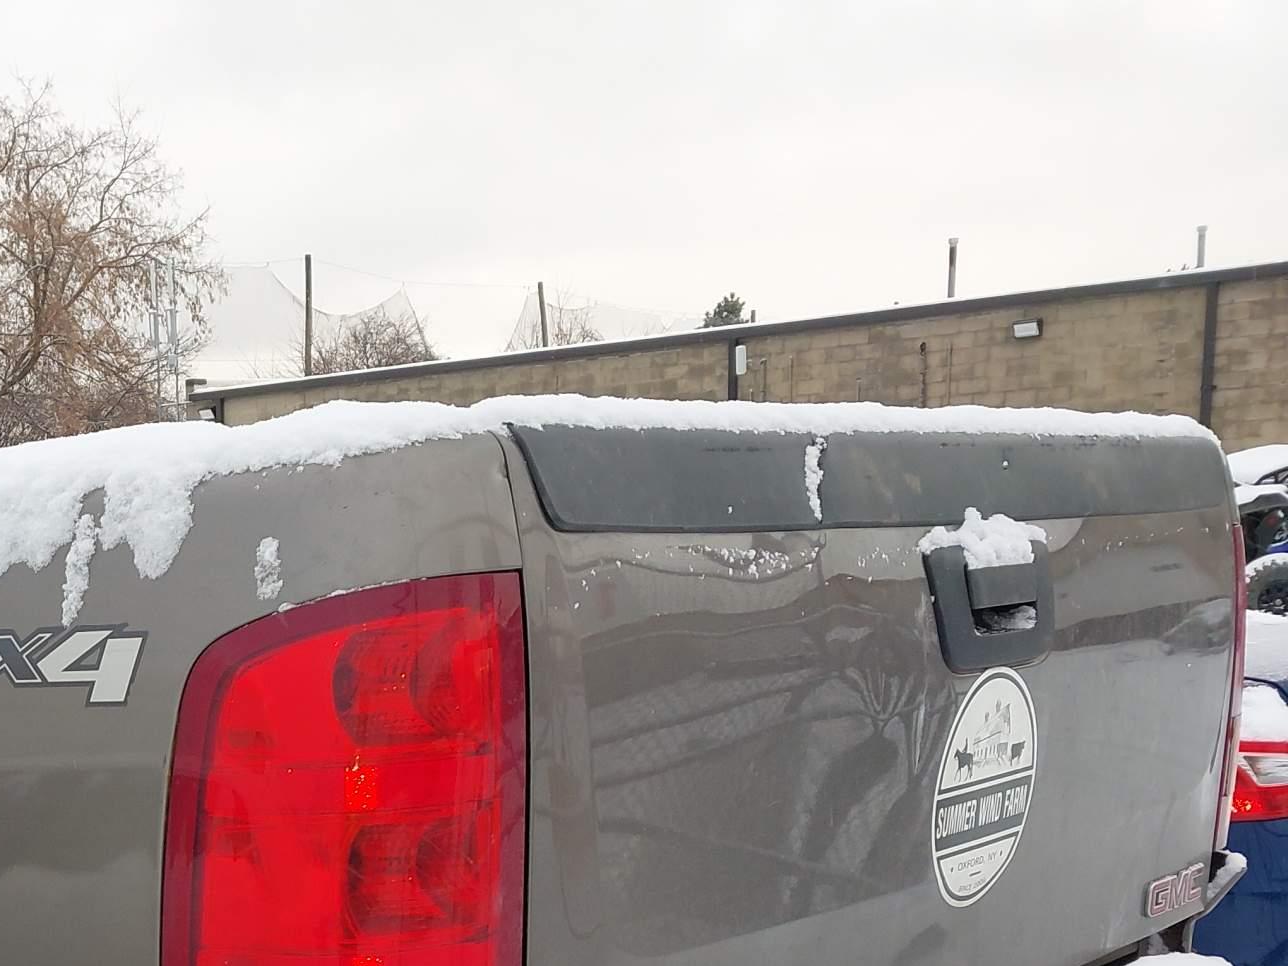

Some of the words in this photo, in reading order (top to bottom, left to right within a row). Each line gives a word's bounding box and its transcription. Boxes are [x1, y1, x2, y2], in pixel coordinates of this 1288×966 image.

[936, 799, 978, 840] SUMMER
[978, 791, 1003, 827] WIND
[1002, 784, 1028, 819] FARM
[1148, 862, 1205, 918] GMC
